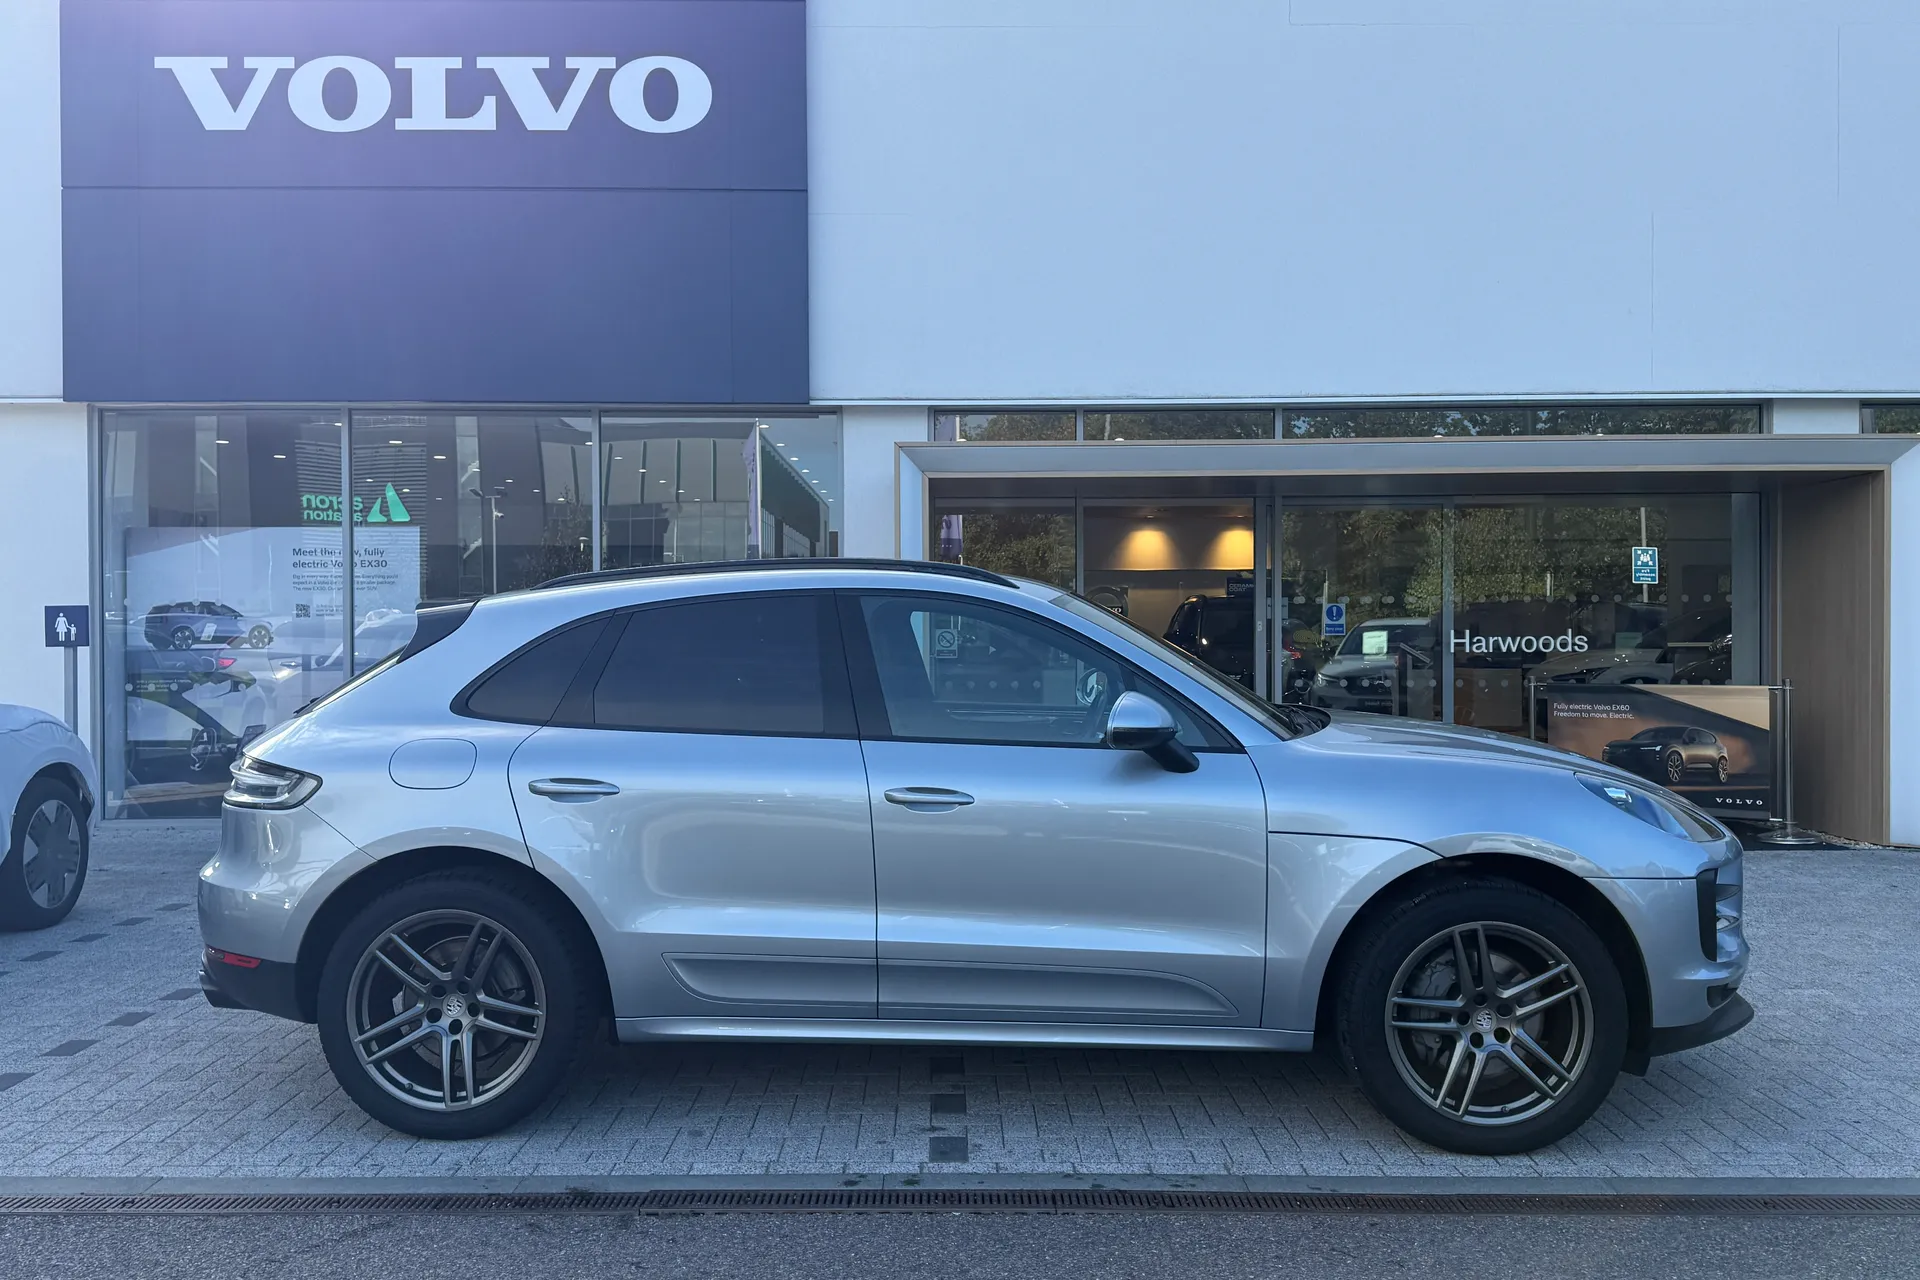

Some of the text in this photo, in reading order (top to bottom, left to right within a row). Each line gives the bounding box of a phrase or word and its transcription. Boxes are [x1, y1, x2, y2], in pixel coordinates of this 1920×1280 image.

[154, 55, 713, 133] VOLVO
[292, 548, 317, 556] Meet
[320, 548, 336, 556] the
[364, 548, 384, 558] fully
[292, 560, 328, 568] electric
[360, 560, 388, 568] EX30
[1450, 628, 1589, 652] Harwoods
[1715, 797, 1763, 805] VOLVO
